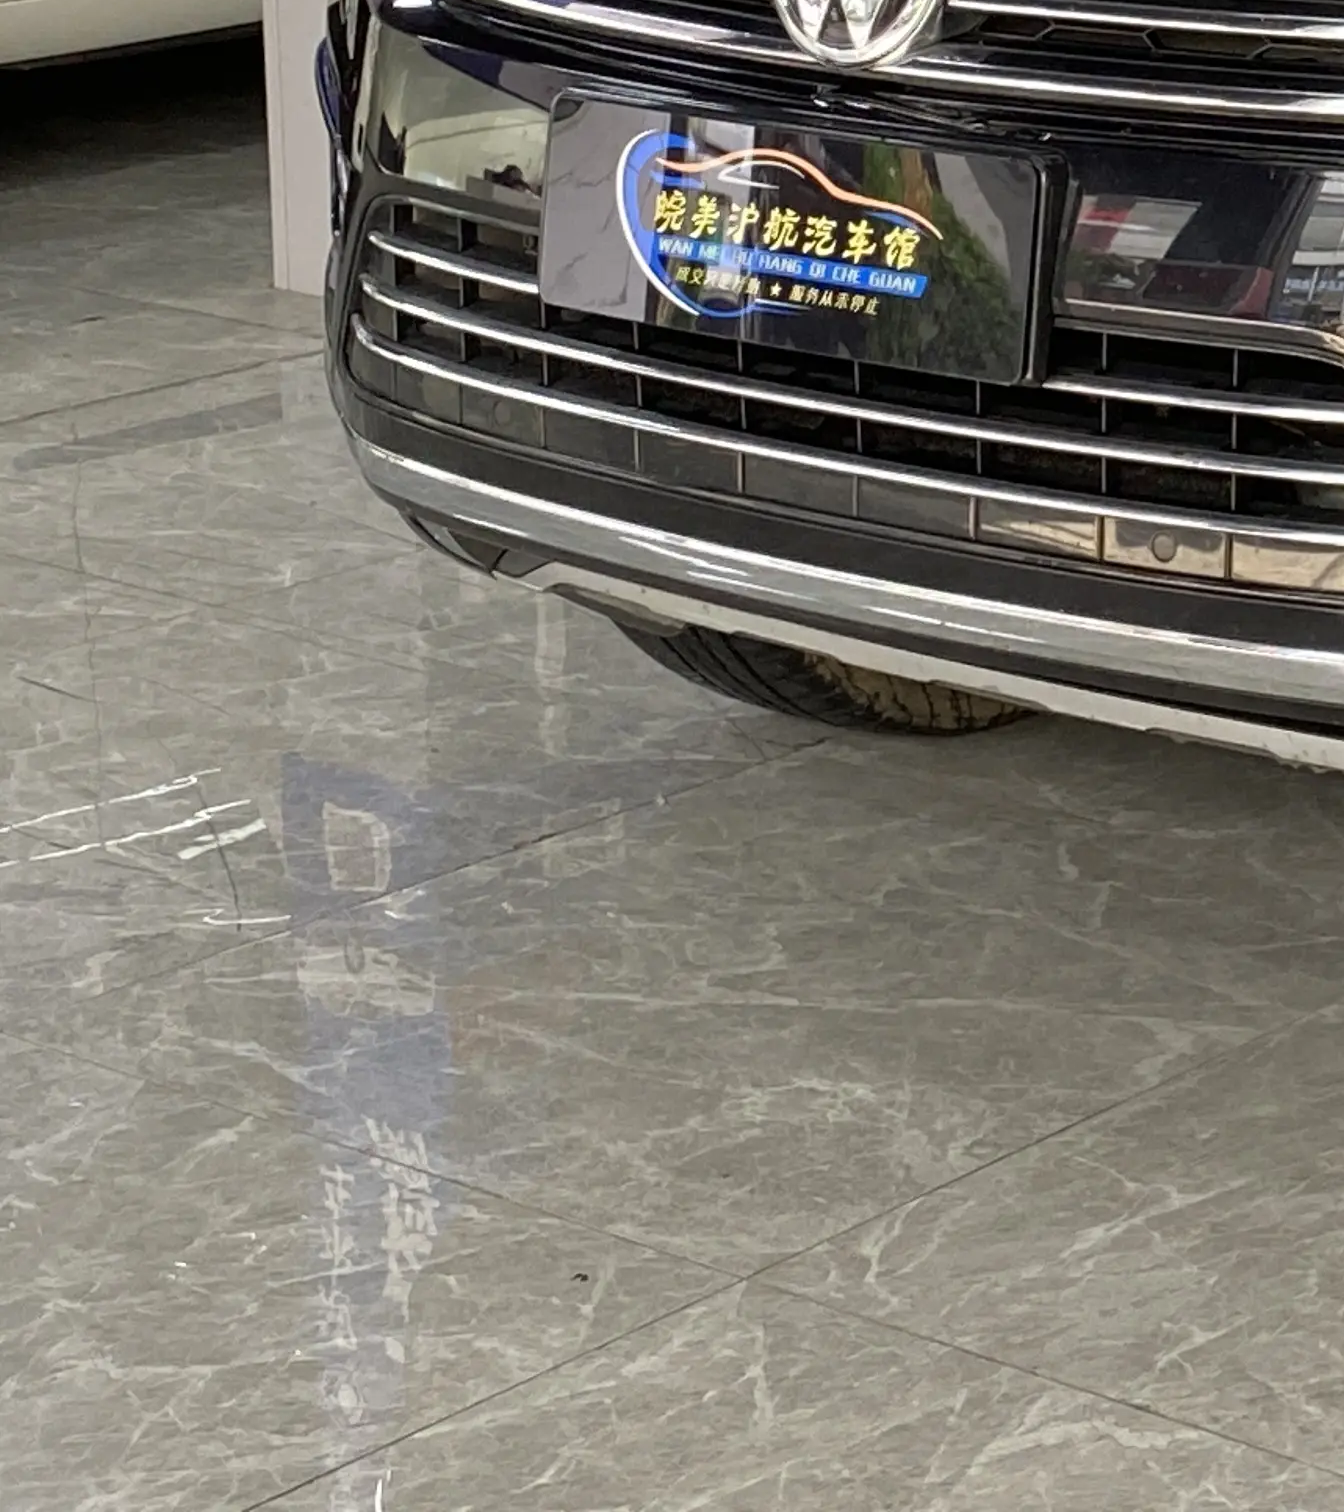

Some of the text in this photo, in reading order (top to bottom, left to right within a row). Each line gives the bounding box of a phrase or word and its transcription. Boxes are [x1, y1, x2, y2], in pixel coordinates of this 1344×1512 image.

[653, 190, 920, 271] 皖美沪航汽车馆
[658, 236, 695, 257] WAN
[758, 254, 804, 276] HANG
[868, 273, 917, 294] GUAN
